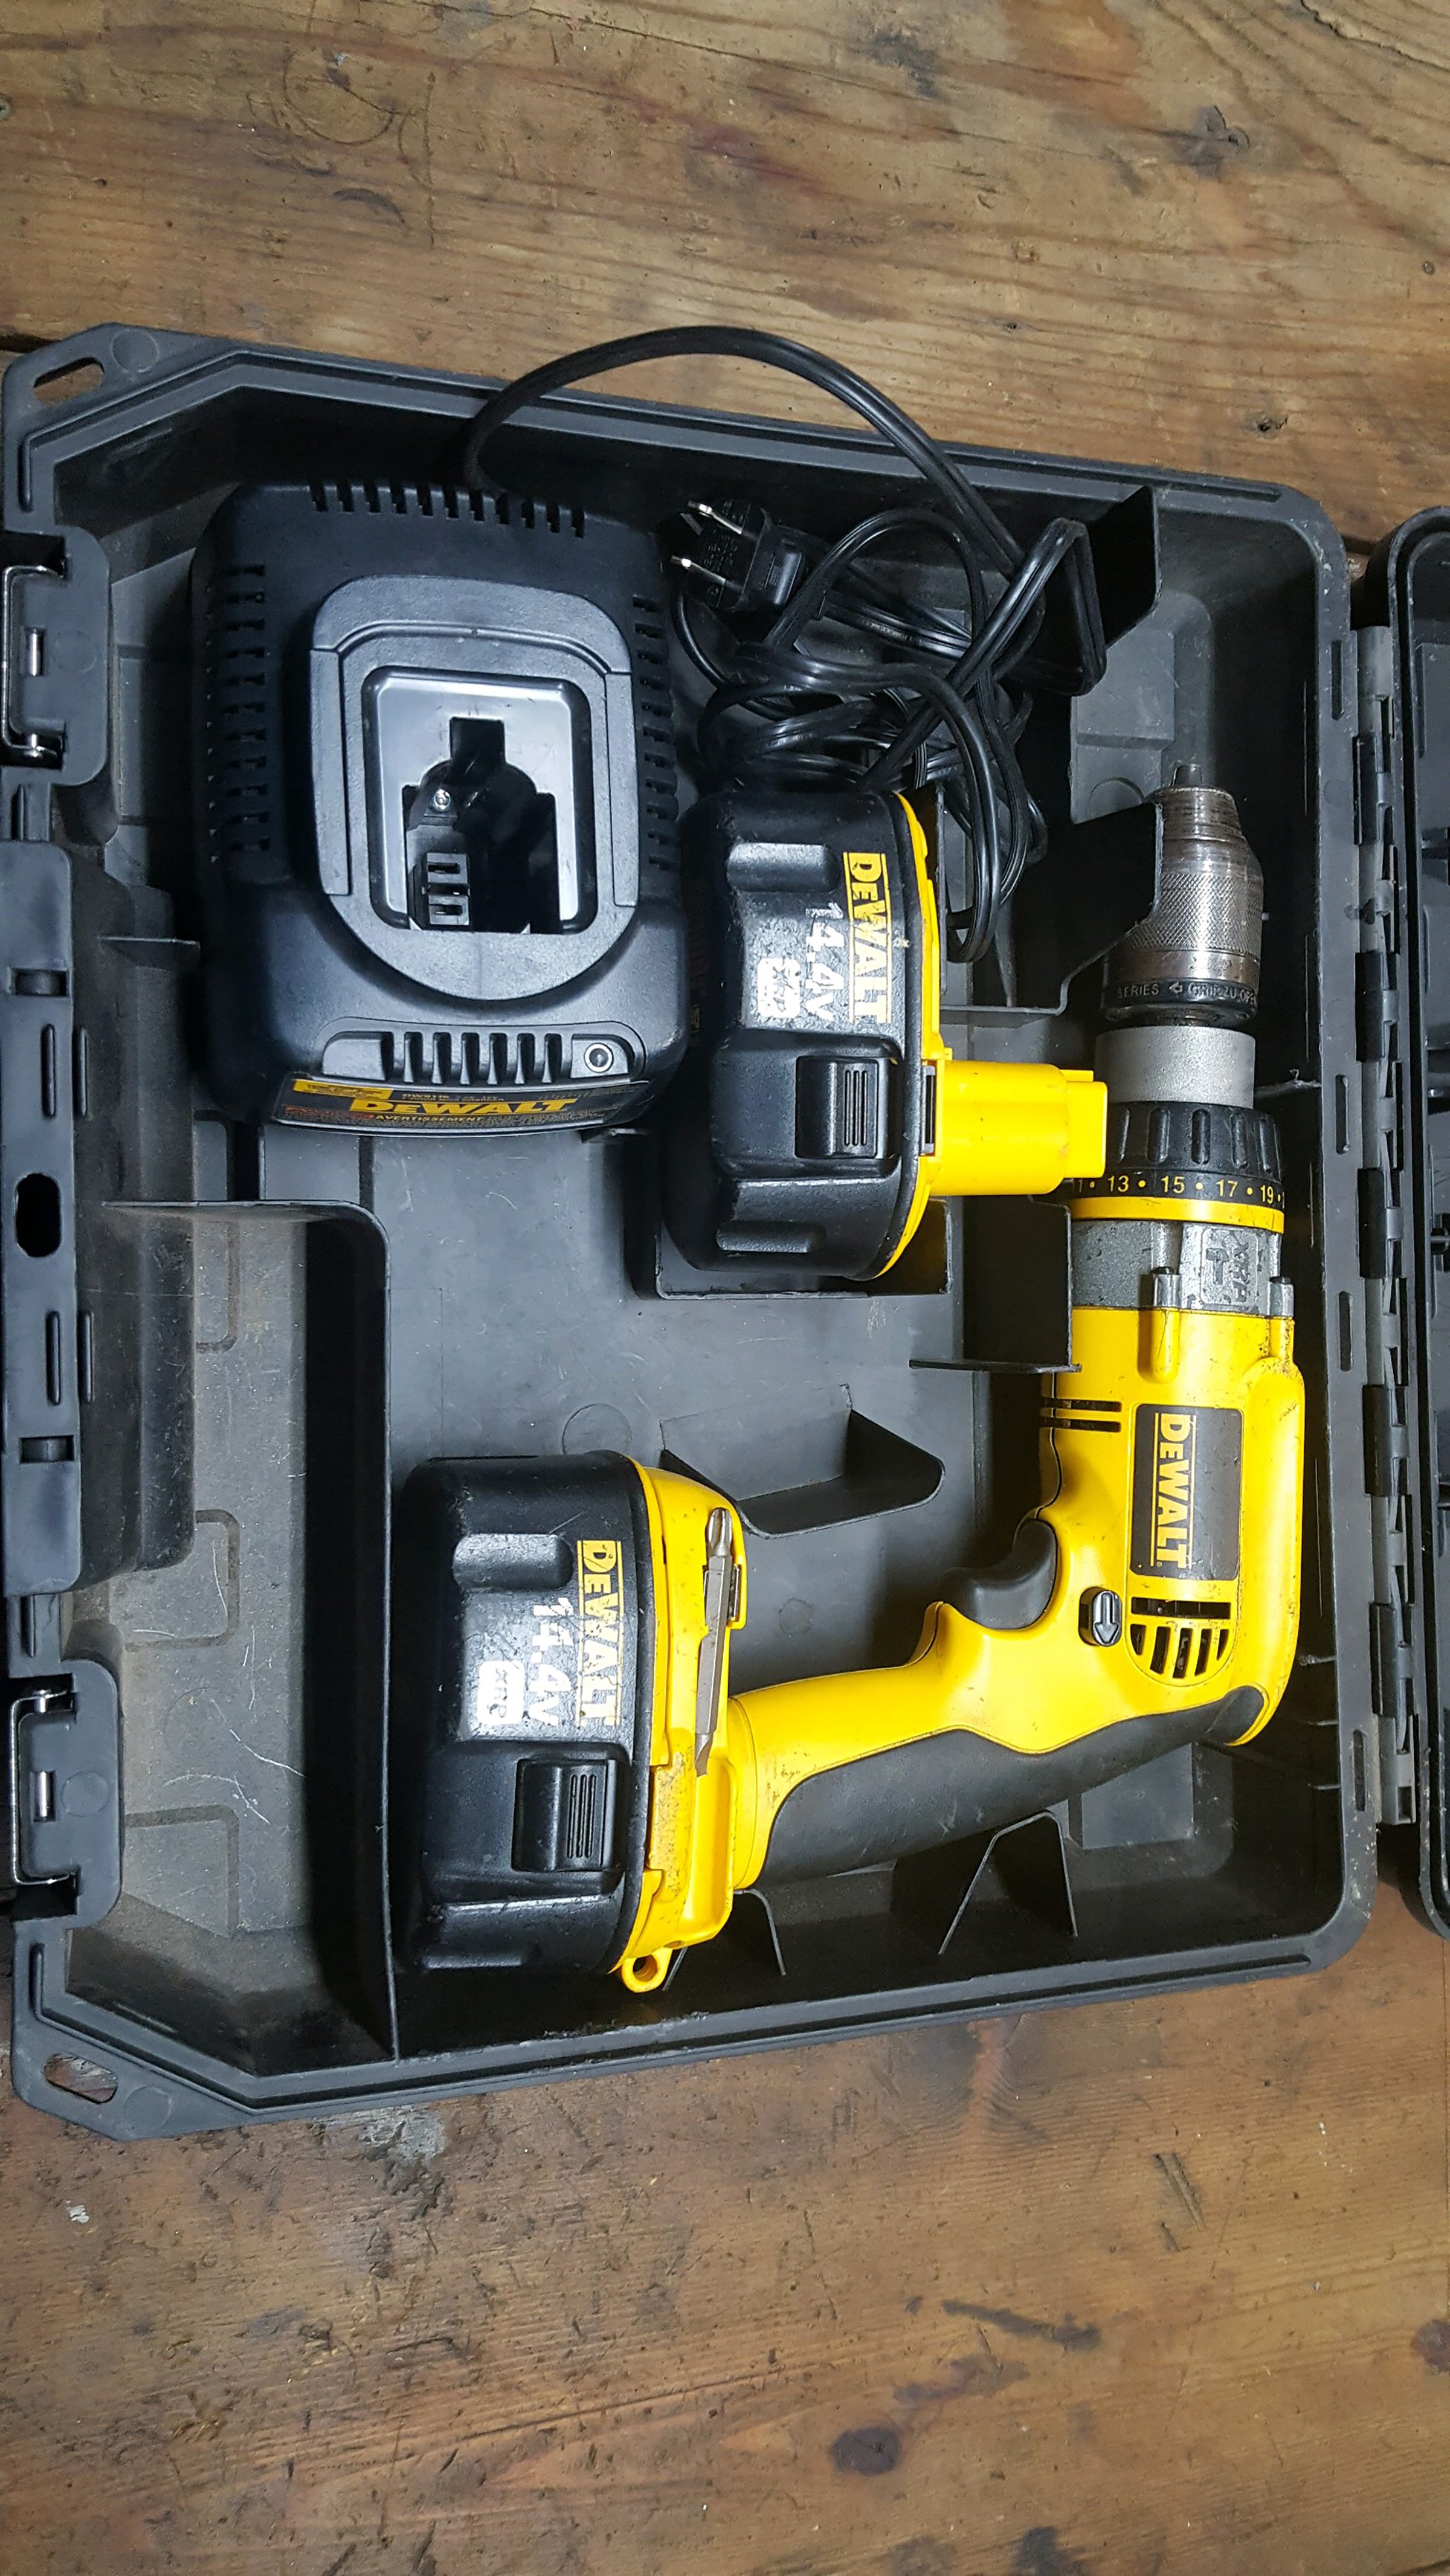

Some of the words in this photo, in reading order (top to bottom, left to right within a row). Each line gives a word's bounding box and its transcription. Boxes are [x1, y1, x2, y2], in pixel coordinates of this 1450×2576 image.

[1108, 1175, 1129, 1192] 13
[1161, 1176, 1185, 1194] 15
[1216, 1179, 1239, 1197] 17
[1260, 1186, 1274, 1204] 19
[1156, 1413, 1191, 1569] DEWALT
